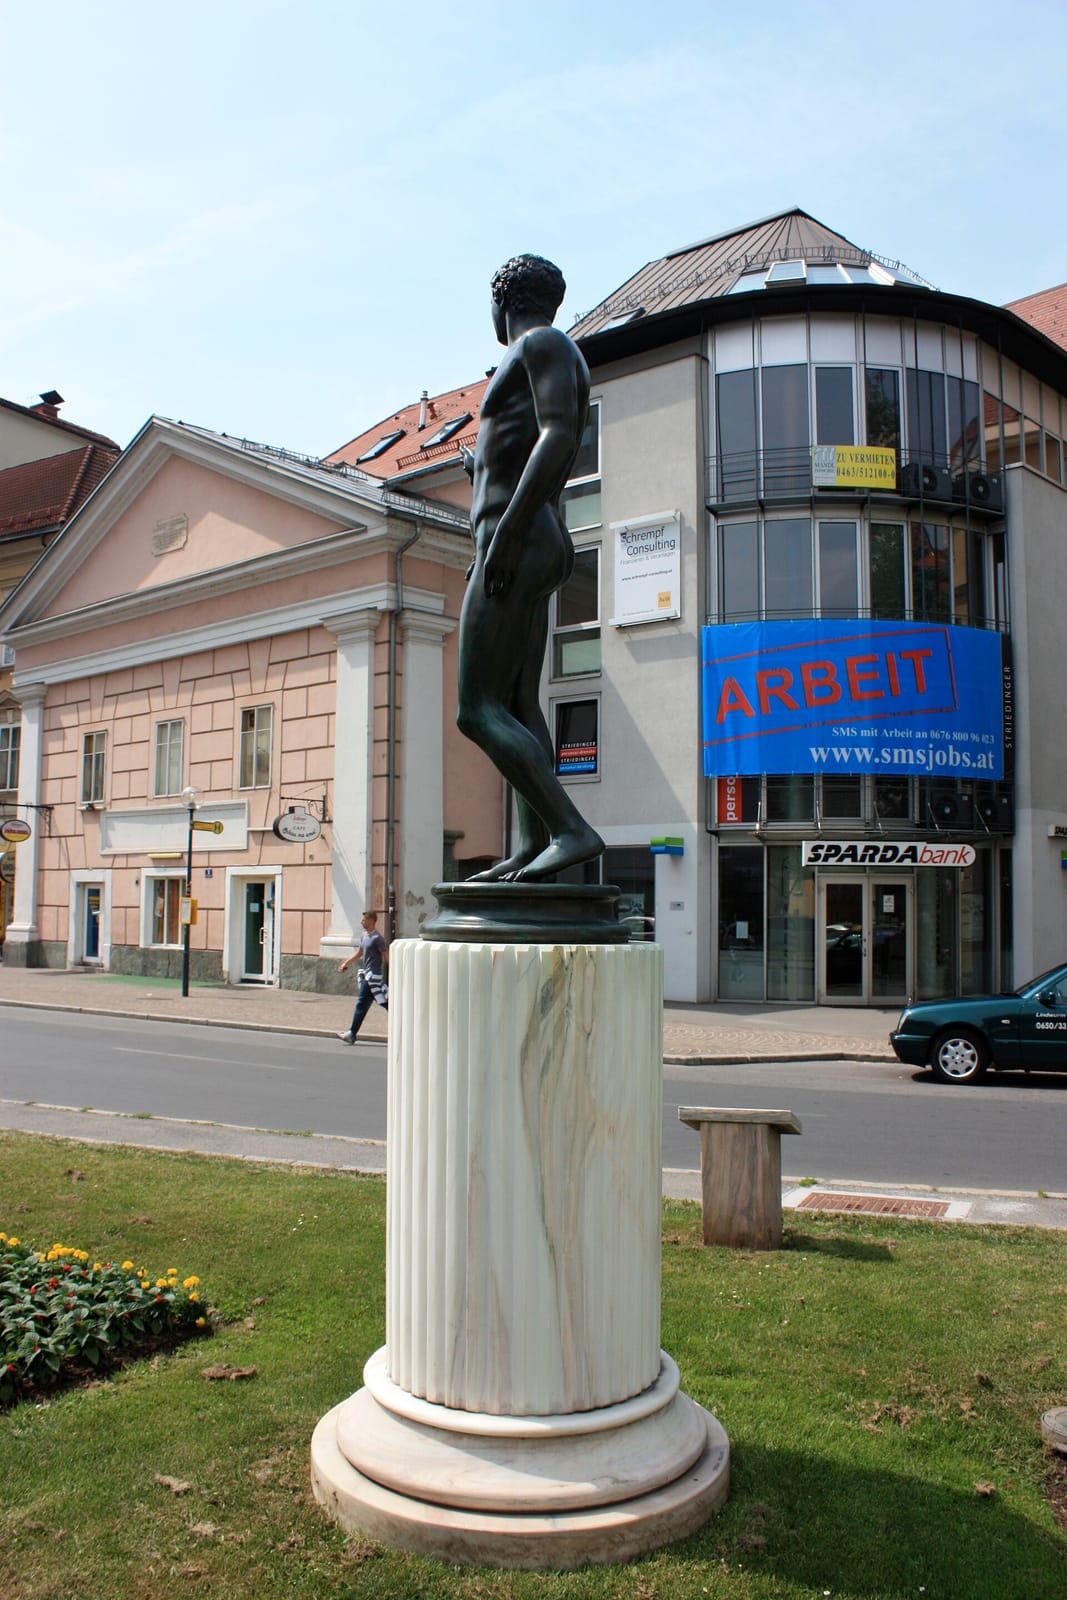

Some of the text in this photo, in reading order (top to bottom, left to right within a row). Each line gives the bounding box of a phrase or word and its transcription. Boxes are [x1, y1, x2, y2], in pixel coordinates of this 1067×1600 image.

[836, 453, 894, 465] ZU VERMIETEN
[627, 539, 676, 556] Consulting
[716, 649, 932, 724] ARBEIT
[1004, 666, 1013, 748] STRIEDINGER
[832, 726, 858, 737] SMS
[860, 727, 878, 737] mit
[881, 728, 913, 738] Arbeit
[915, 731, 928, 739] an
[930, 730, 951, 741] 0676
[952, 731, 969, 742] 800
[808, 743, 995, 771] www.smsjobs.at
